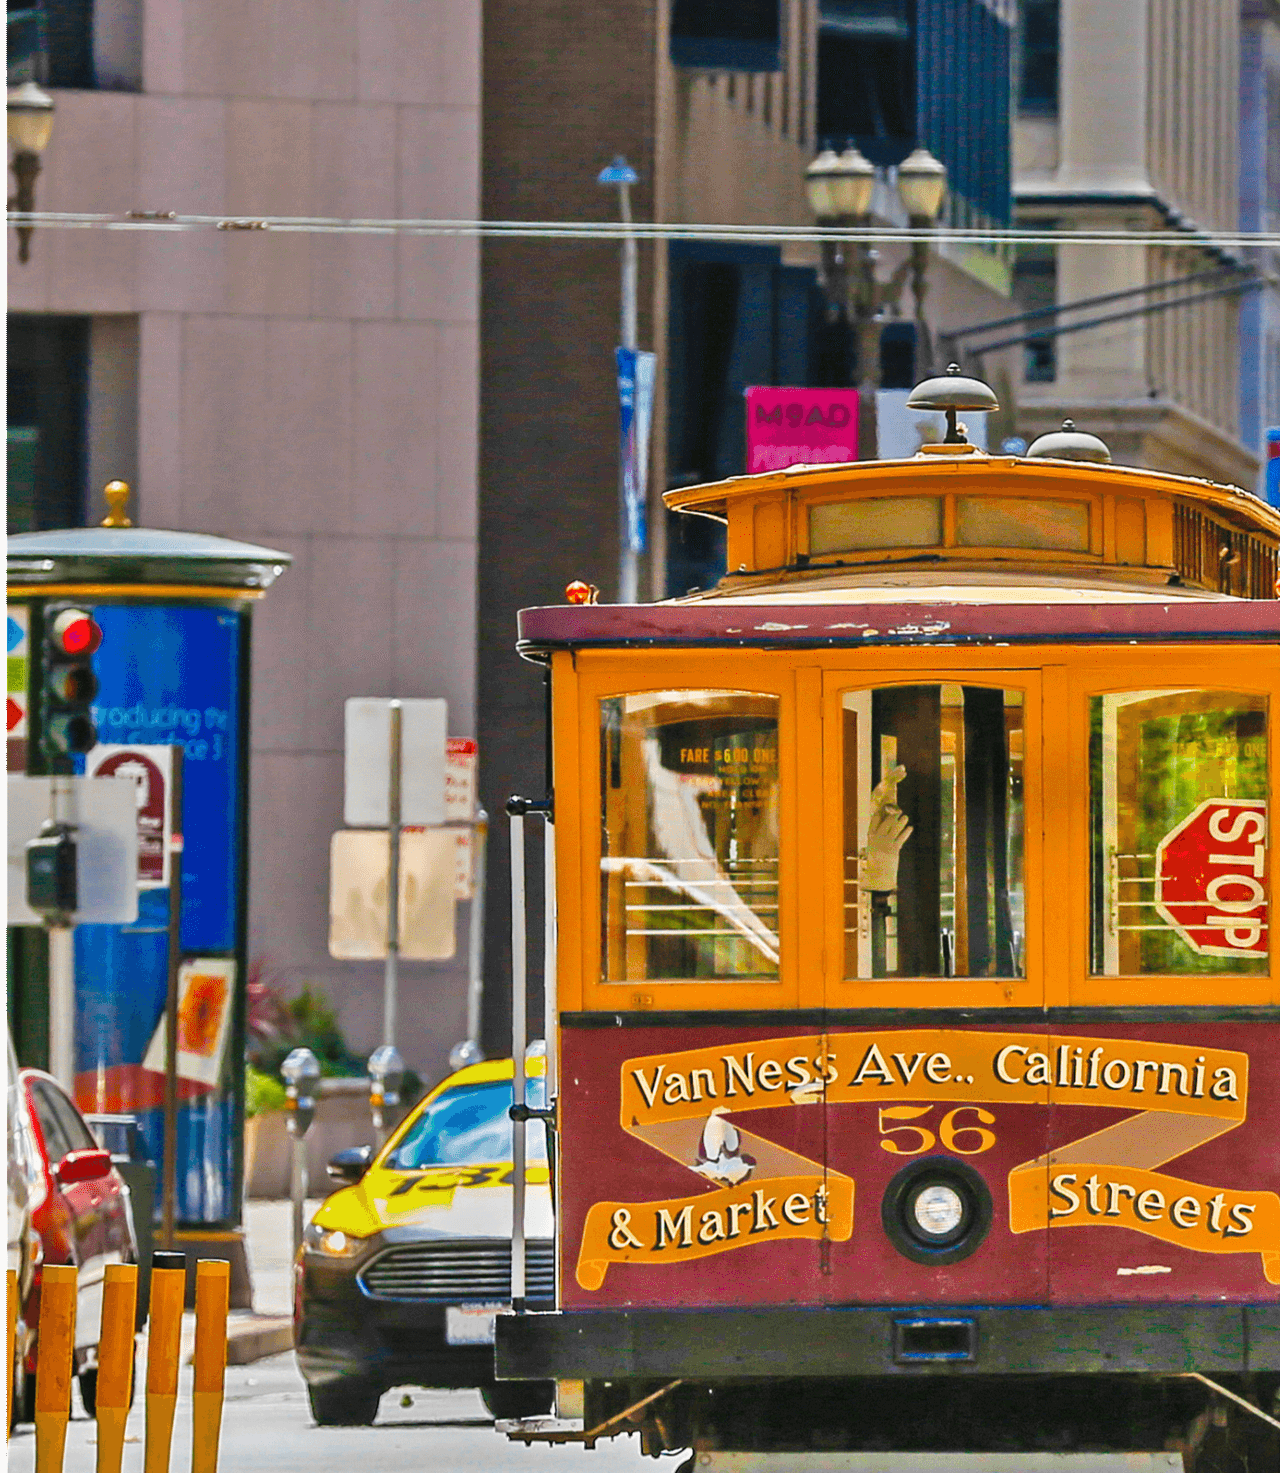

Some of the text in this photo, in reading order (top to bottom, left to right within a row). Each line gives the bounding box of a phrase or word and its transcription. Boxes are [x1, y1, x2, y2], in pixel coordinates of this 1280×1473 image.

[680, 748, 710, 763] FARE
[1206, 808, 1266, 948] STOP
[633, 1063, 716, 1109] Van
[722, 1052, 839, 1097] Ness
[998, 1043, 1239, 1101] California
[878, 1104, 997, 1156] 56
[609, 1183, 832, 1249] & Market
[1050, 1173, 1257, 1235] Streets
